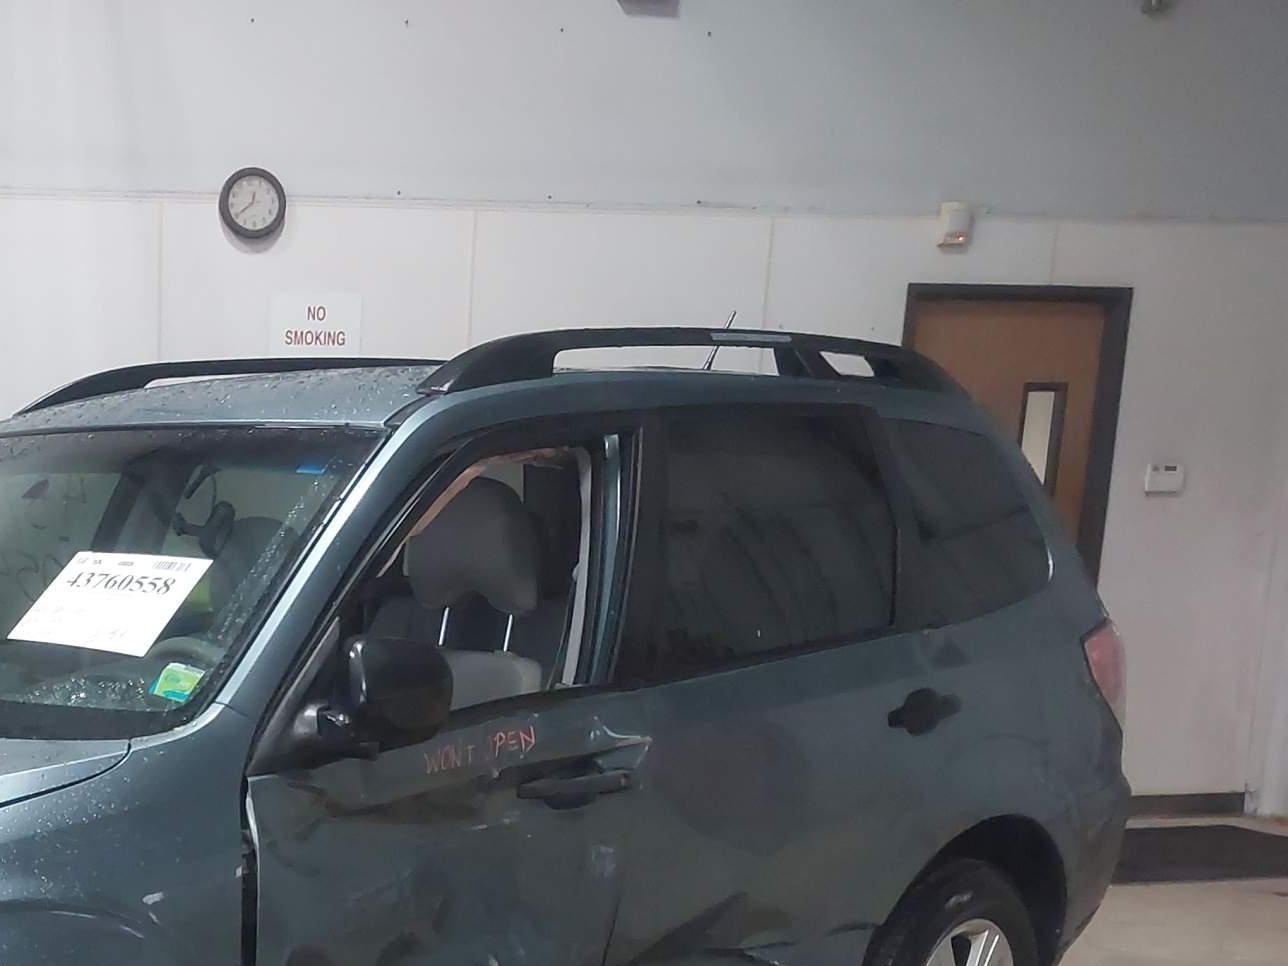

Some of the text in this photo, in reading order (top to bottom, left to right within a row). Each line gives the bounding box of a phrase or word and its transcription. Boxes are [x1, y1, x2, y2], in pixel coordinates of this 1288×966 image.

[307, 305, 327, 322] NO
[285, 329, 346, 347] SMOKING
[66, 571, 176, 595] 43760558
